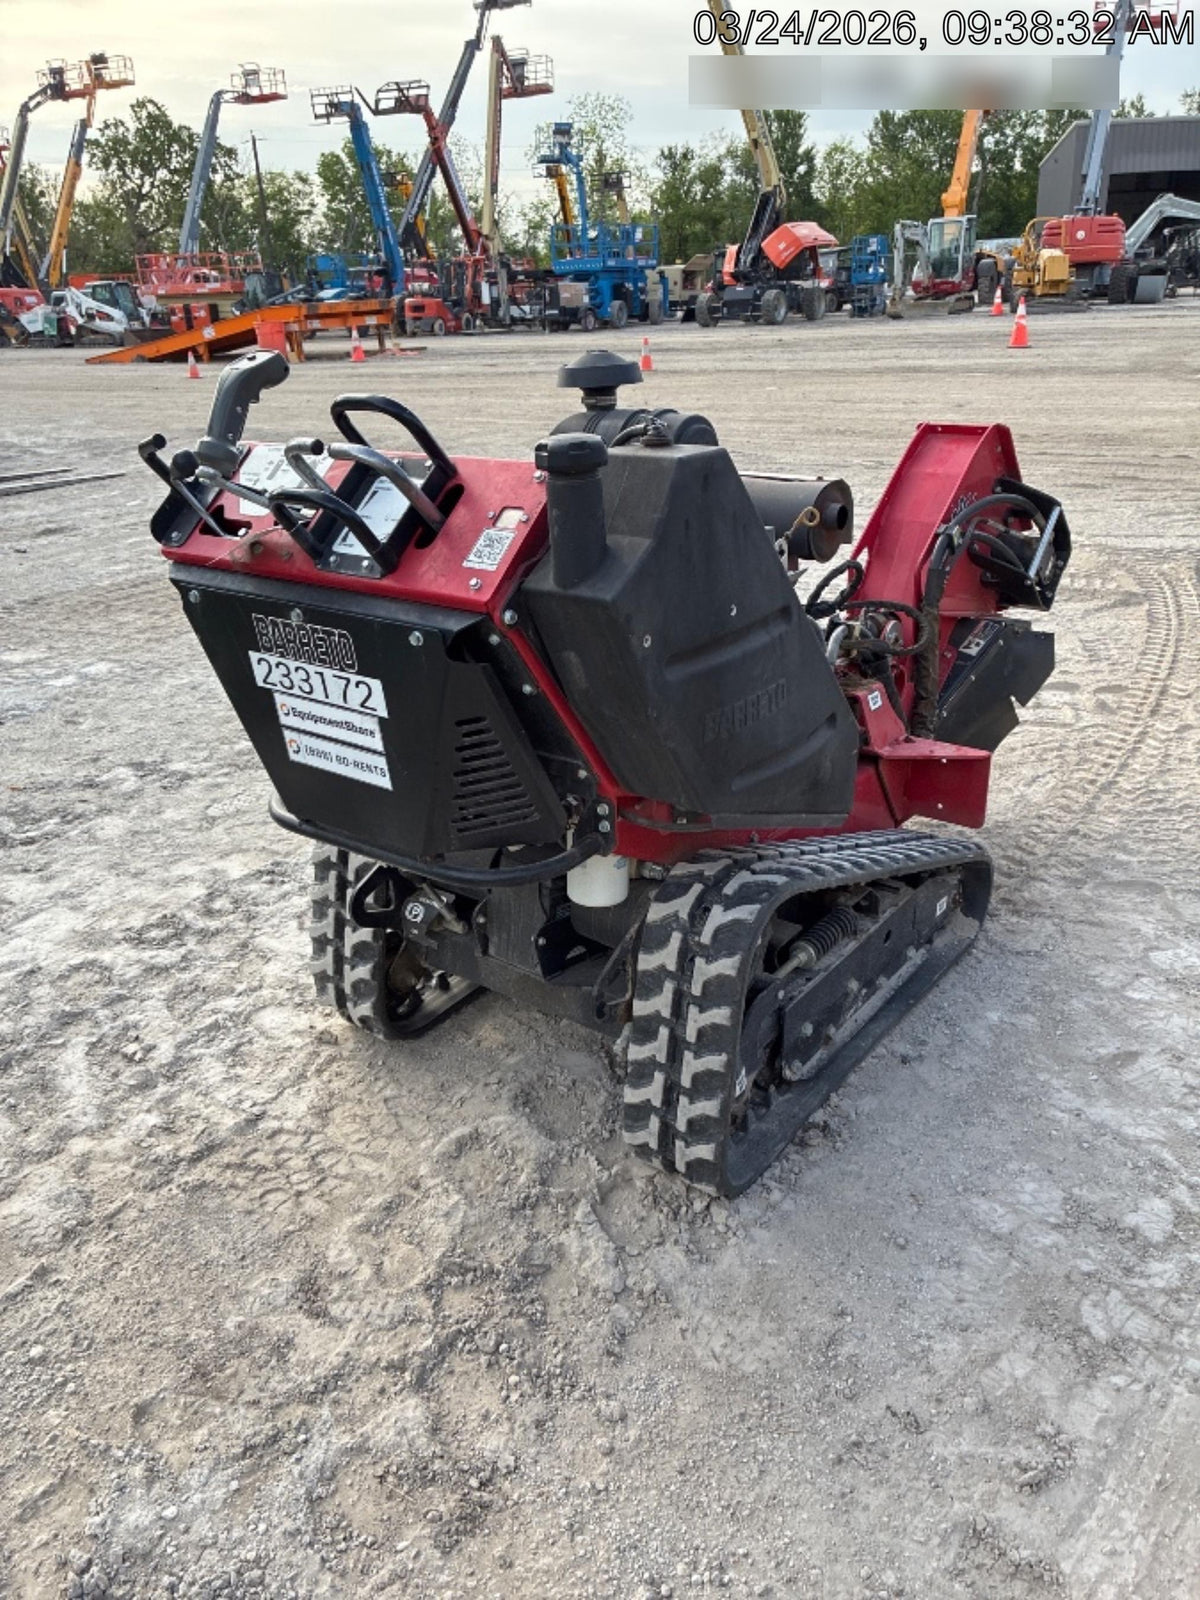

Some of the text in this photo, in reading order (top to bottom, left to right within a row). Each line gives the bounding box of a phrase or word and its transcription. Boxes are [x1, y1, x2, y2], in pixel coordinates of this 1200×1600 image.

[252, 612, 358, 673] BARRETO
[257, 657, 378, 712] 233172
[291, 707, 376, 739] EquipmentShare
